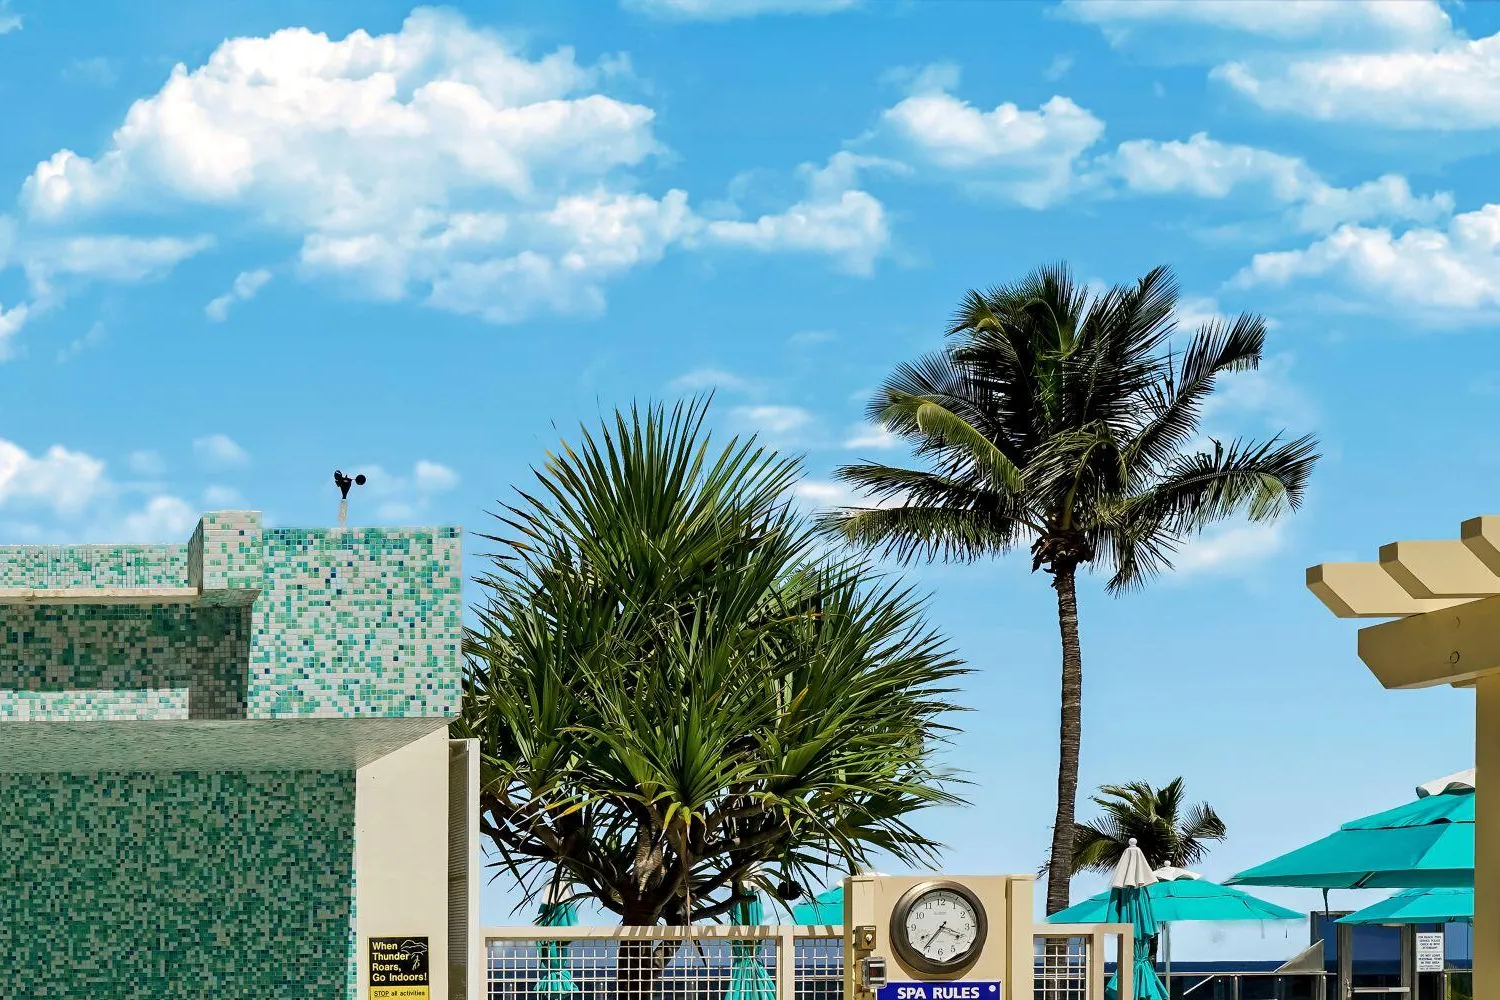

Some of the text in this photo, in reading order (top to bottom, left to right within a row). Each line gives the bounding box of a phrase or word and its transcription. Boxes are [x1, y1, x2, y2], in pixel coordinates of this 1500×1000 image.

[372, 942, 398, 950] When
[372, 952, 409, 960] Thunder
[372, 962, 401, 972] Roars,
[372, 972, 427, 982] Go Indoors!
[898, 987, 979, 999] SPA RULES
